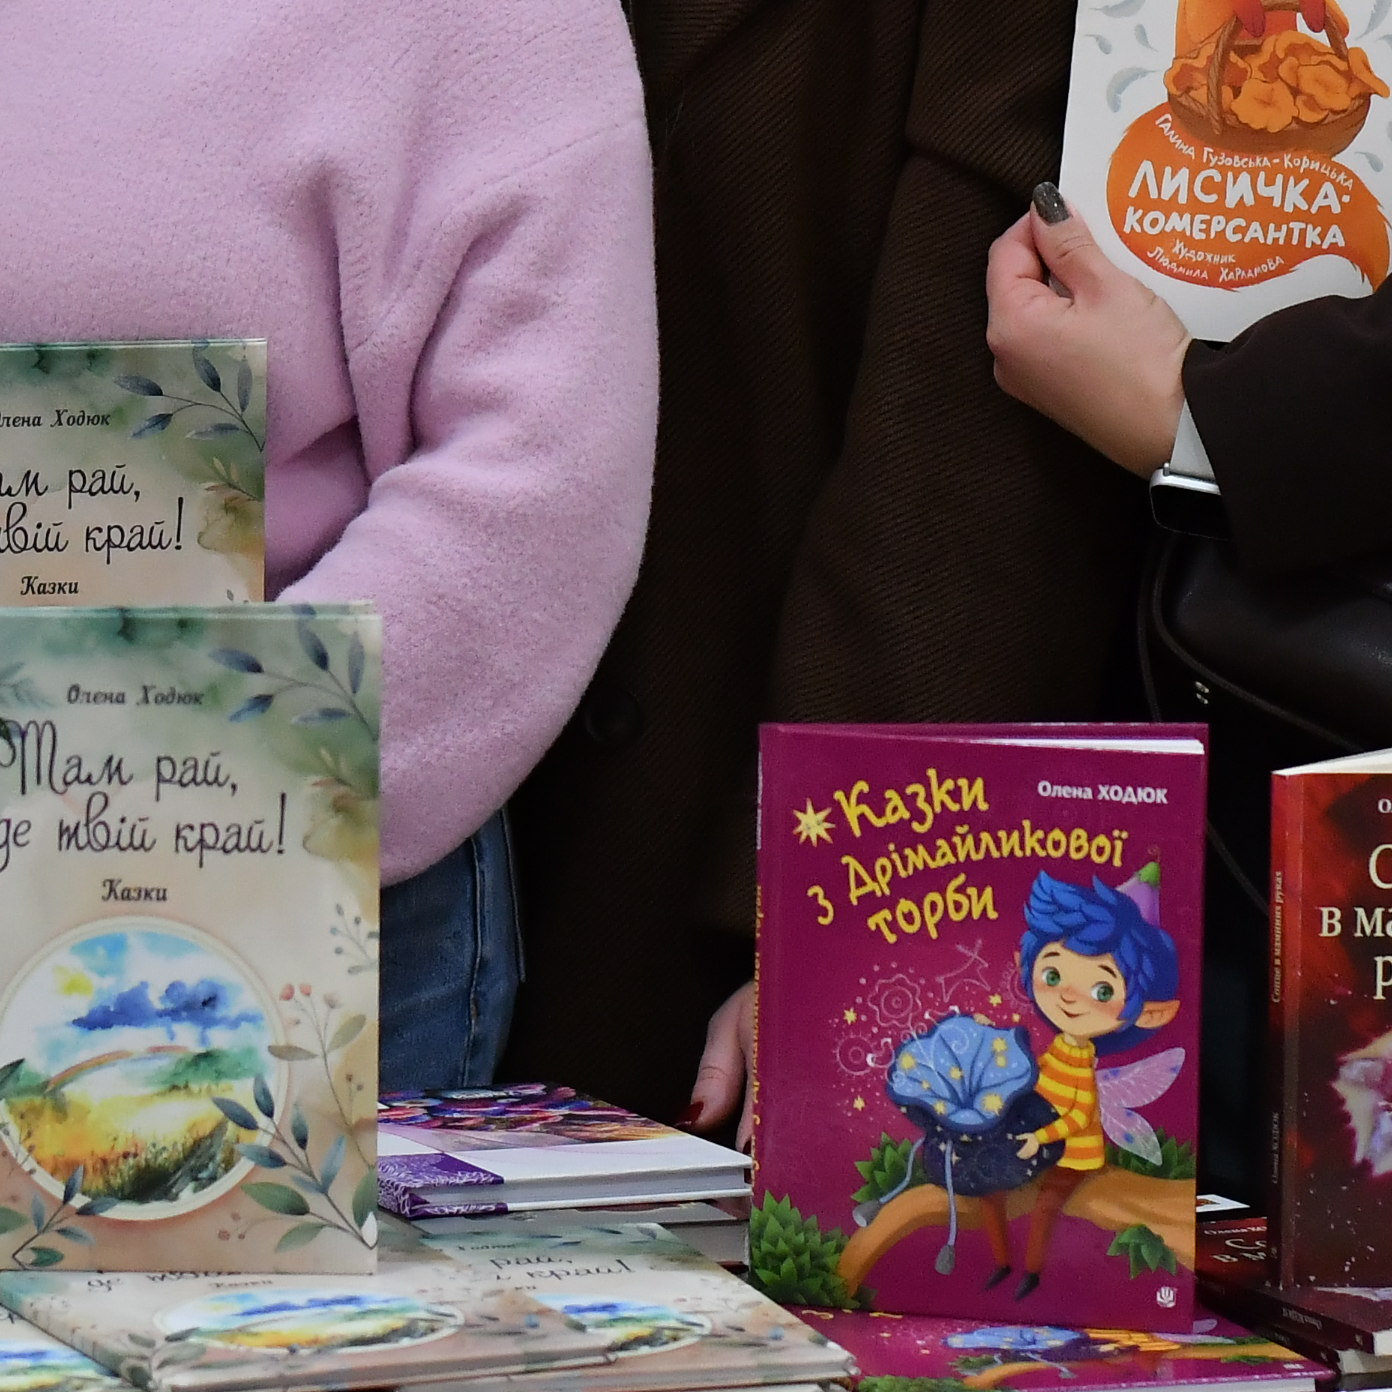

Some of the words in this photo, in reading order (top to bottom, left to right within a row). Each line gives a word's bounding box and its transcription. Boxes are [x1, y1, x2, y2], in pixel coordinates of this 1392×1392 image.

[1123, 206, 1346, 249] КОМЕРСАНТКА
[50, 408, 111, 429] Ходюк
[67, 463, 141, 510] рай,
[84, 497, 184, 565] край!
[20, 575, 79, 597] Казки
[66, 683, 126, 707] Олена
[135, 683, 205, 707] Ходюк
[155, 751, 239, 802] рай,
[1038, 780, 1093, 801] Олена
[1097, 784, 1168, 805] ХОДЮК
[834, 767, 989, 839] Казки
[57, 791, 157, 854] твій
[174, 792, 286, 868] край!
[840, 818, 1129, 906] Дрімайликової
[101, 878, 168, 903] Казки
[867, 872, 999, 944] торби
[1318, 907, 1342, 937] в
